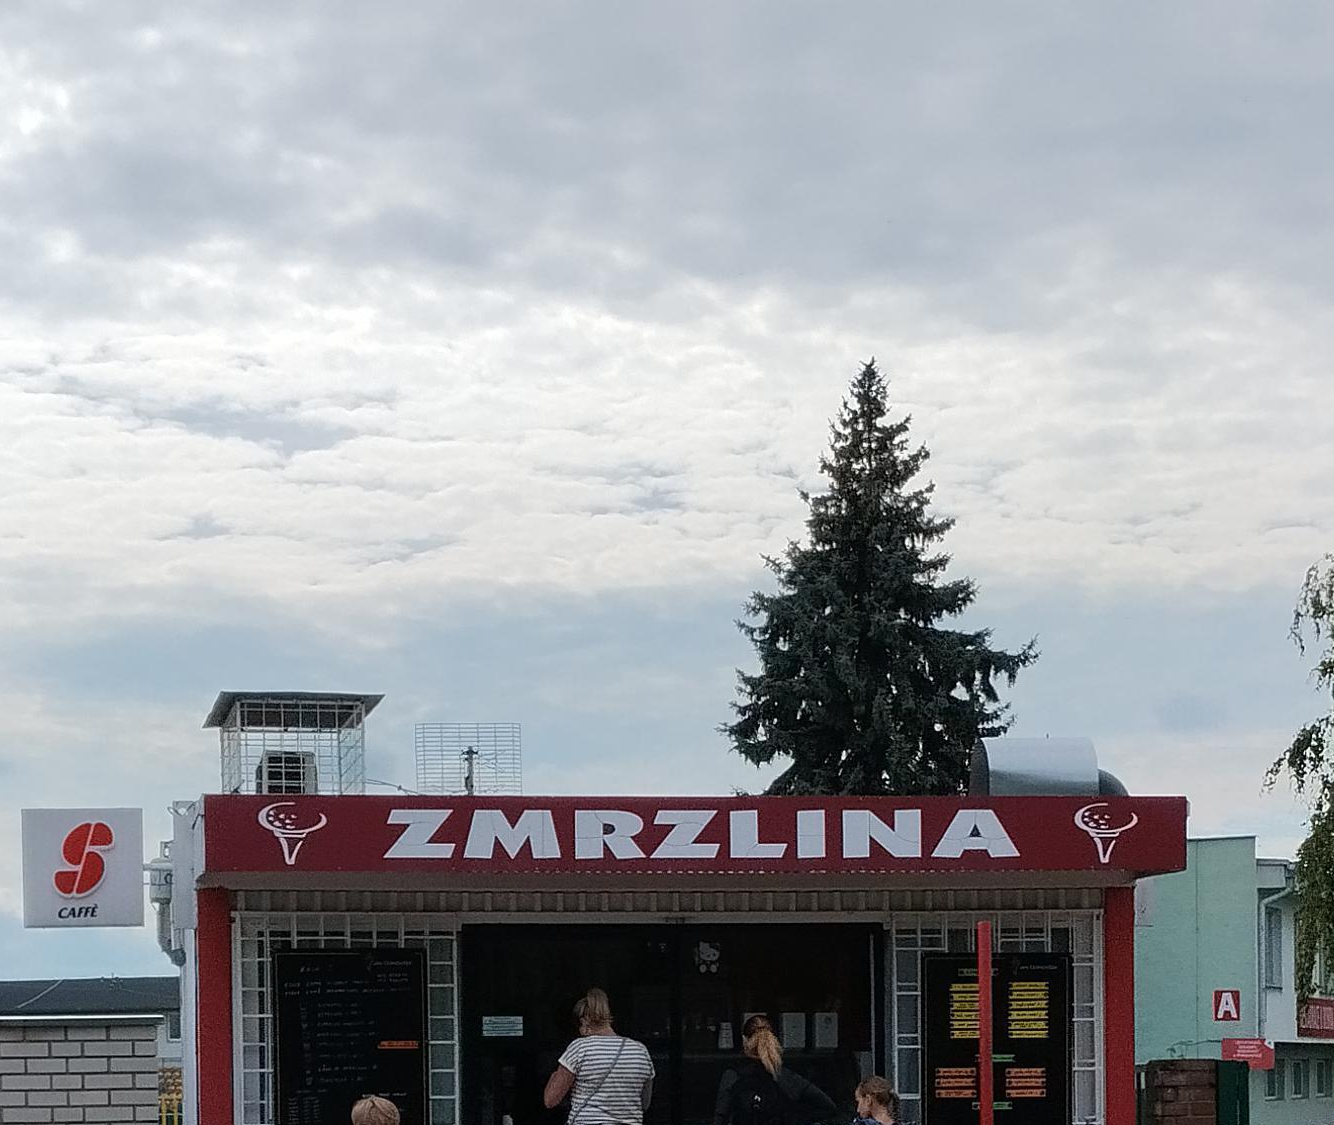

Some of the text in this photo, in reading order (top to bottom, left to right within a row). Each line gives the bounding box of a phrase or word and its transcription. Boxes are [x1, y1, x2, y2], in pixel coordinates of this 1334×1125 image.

[383, 807, 1021, 861] ZMRZLINA
[58, 904, 98, 919] CAFFÈ
[1217, 992, 1238, 1018] A
